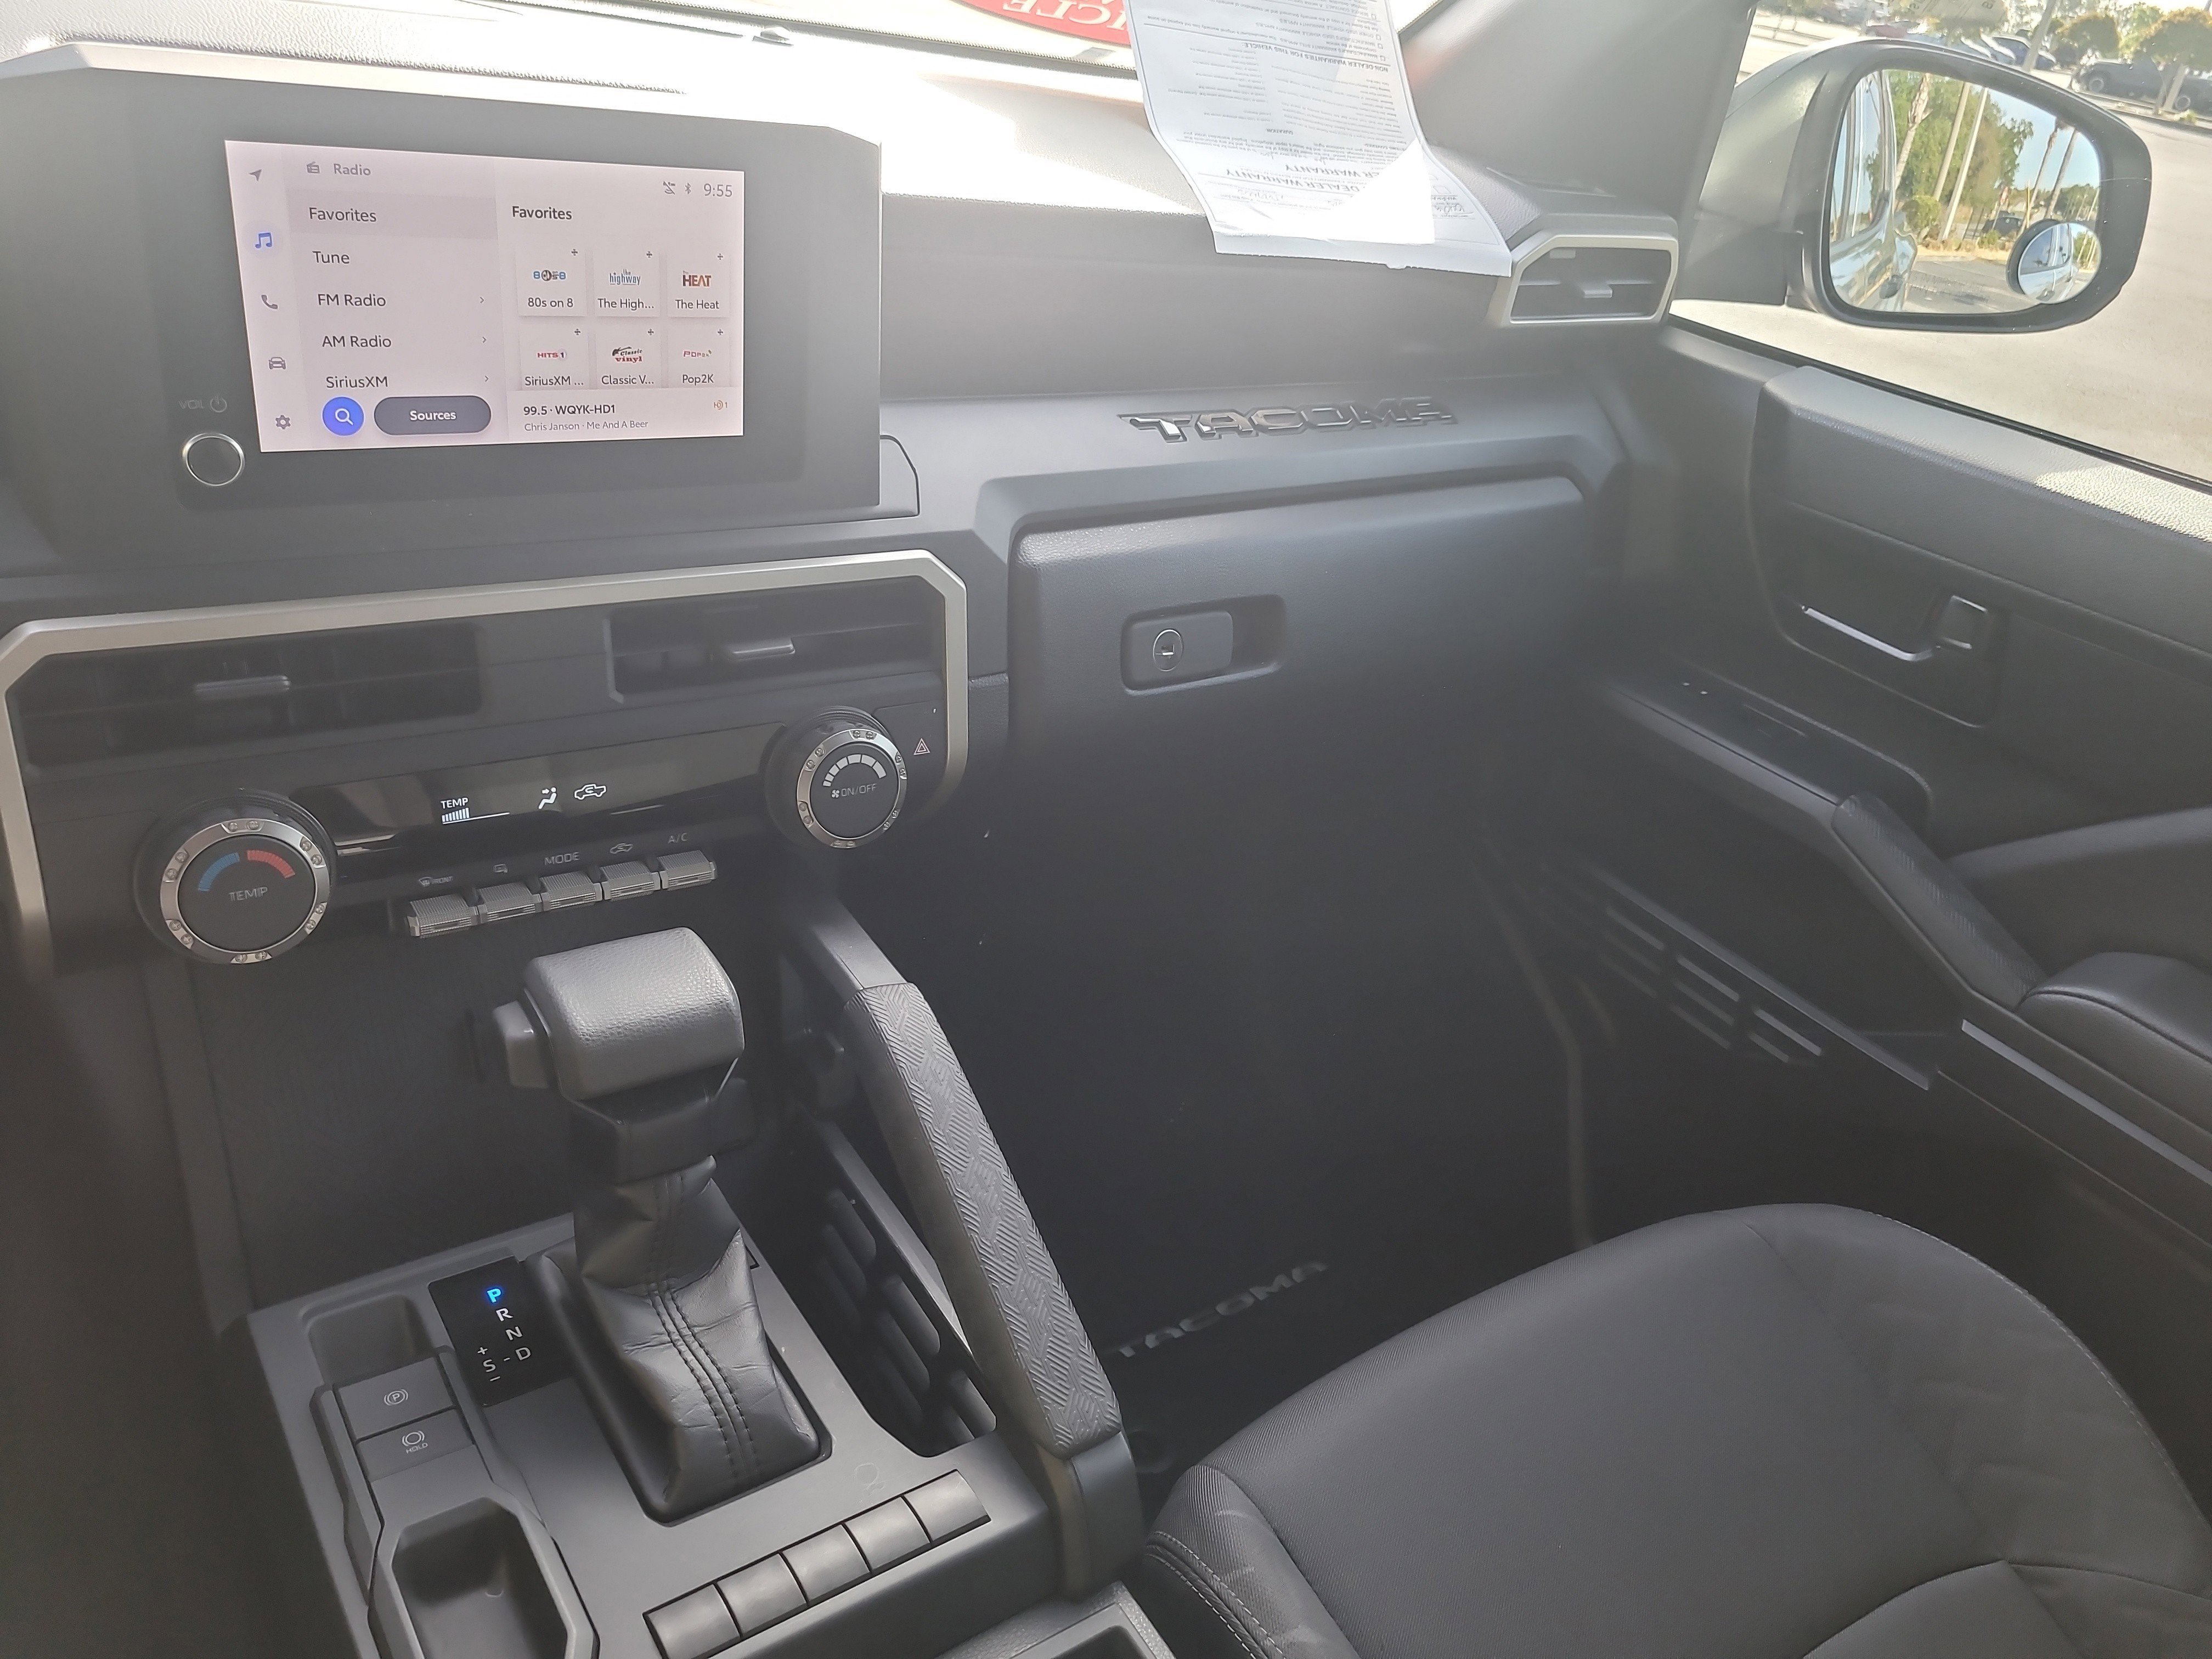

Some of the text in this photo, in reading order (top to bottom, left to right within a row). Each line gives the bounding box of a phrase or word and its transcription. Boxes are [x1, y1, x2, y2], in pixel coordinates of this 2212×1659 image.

[334, 163, 371, 176] Radio
[1284, 164, 1361, 178] WARRANTY
[1225, 169, 1360, 192] DEALER WARRANTY
[703, 183, 733, 198] 9:55
[309, 207, 377, 222] Favorites
[512, 206, 572, 220] Favorites
[312, 251, 350, 264] Tune
[610, 272, 641, 286] highway
[682, 275, 712, 287] HEAT
[318, 294, 386, 307] FM Radio
[528, 297, 574, 308] 80s on 8
[597, 298, 618, 309] The
[675, 300, 720, 309] The Heat
[322, 335, 392, 348] AM Radio
[326, 376, 388, 388] SiriusXM
[524, 376, 571, 386] SiriusXM
[601, 375, 636, 385] Classic
[682, 374, 714, 386] Pop2K
[410, 410, 456, 421] Sources
[523, 404, 616, 416] 99.5 WQYK-HD1
[524, 422, 547, 432] Chris
[549, 422, 580, 431] Janson
[586, 421, 600, 430] Me
[602, 420, 619, 429] And
[630, 420, 648, 428] Beer
[1119, 396, 1459, 443] TACOMA
[840, 781, 877, 798] ON/OFF
[441, 797, 469, 809] TEMP
[667, 831, 689, 844] A/C
[544, 851, 580, 866] MODE
[228, 885, 268, 902] TEMP
[486, 1287, 503, 1304] P
[496, 1307, 514, 1322] R
[505, 1325, 523, 1340] N
[482, 1346, 531, 1373] S D
[405, 1442, 428, 1454] HOLD
